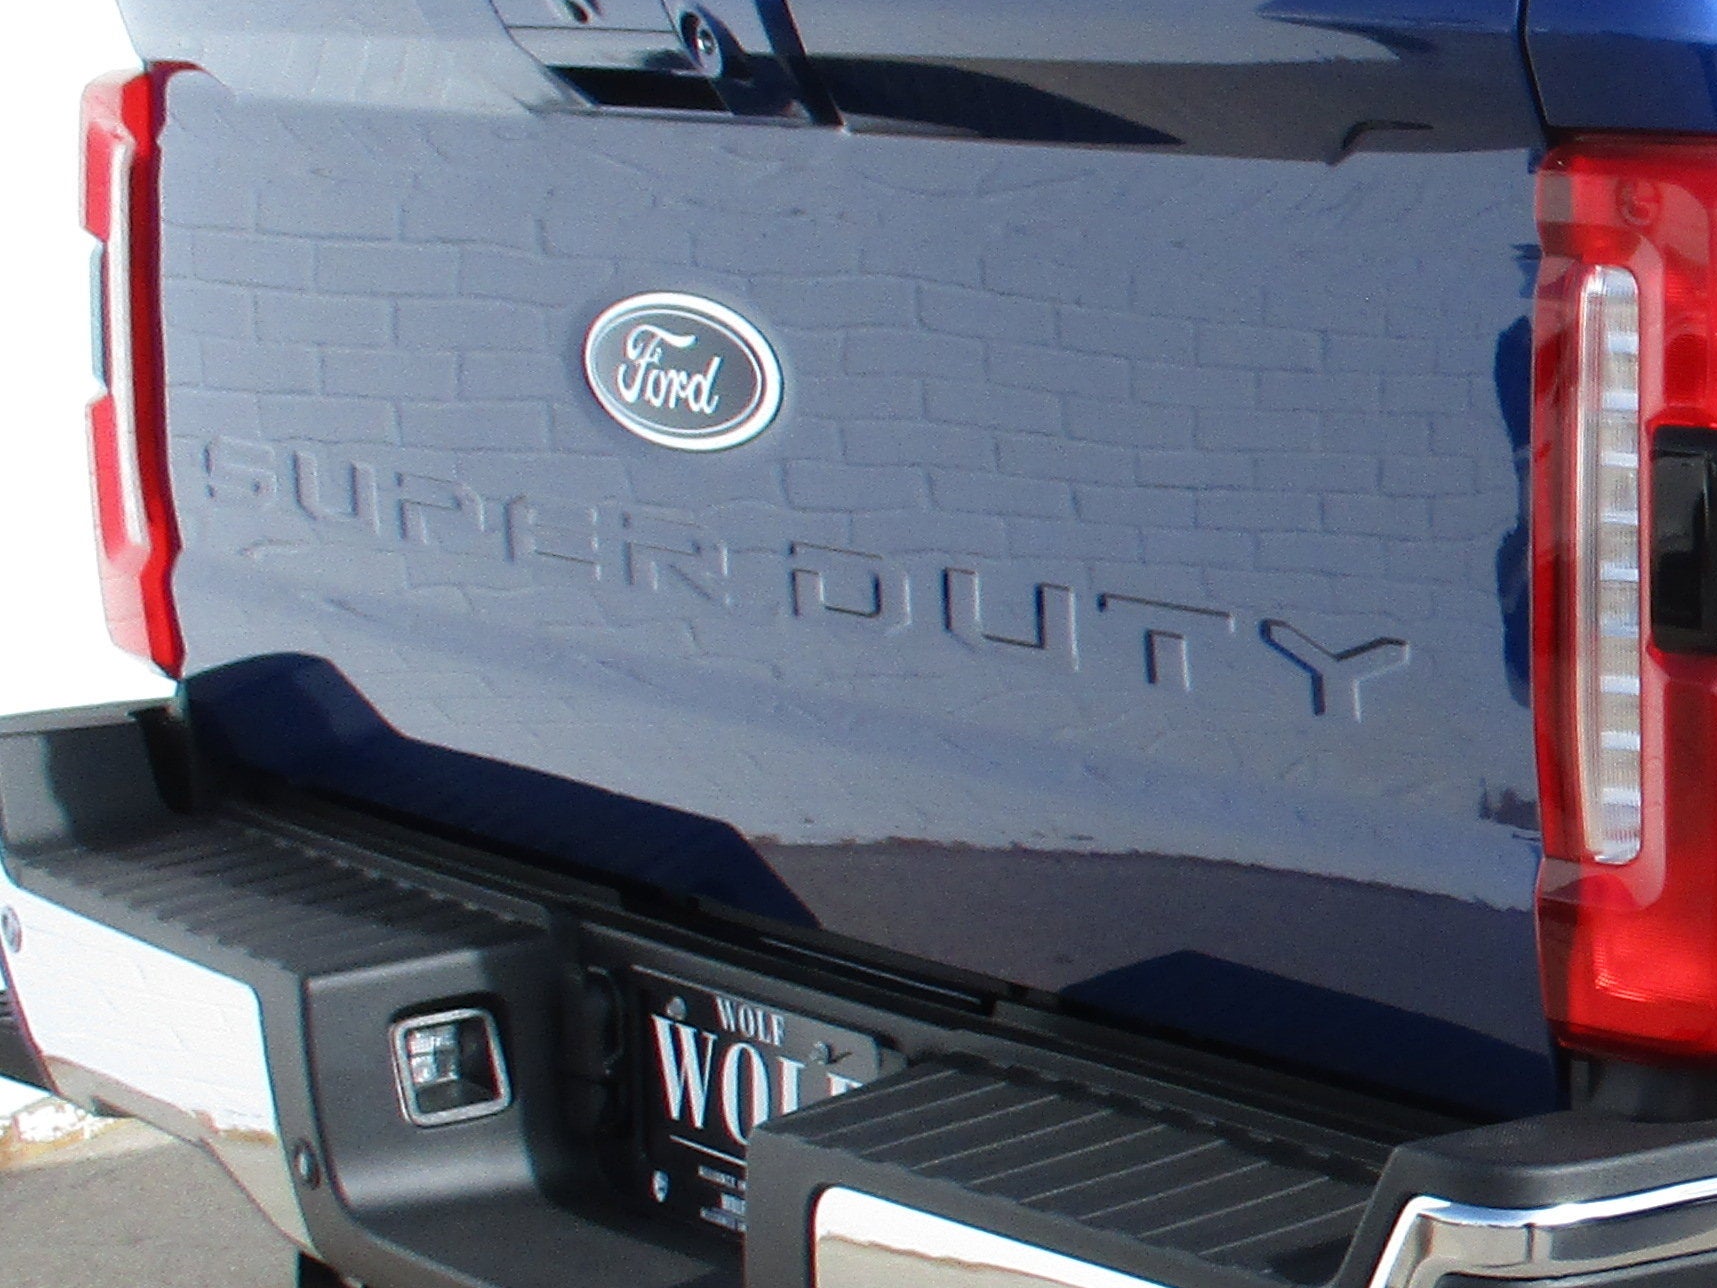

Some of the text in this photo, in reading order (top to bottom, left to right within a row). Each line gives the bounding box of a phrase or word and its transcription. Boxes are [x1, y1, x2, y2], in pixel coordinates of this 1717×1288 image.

[617, 324, 722, 414] Ford
[203, 434, 1412, 721] SUPER DUTY
[714, 995, 786, 1048] WOLF
[651, 1013, 864, 1146] WO
